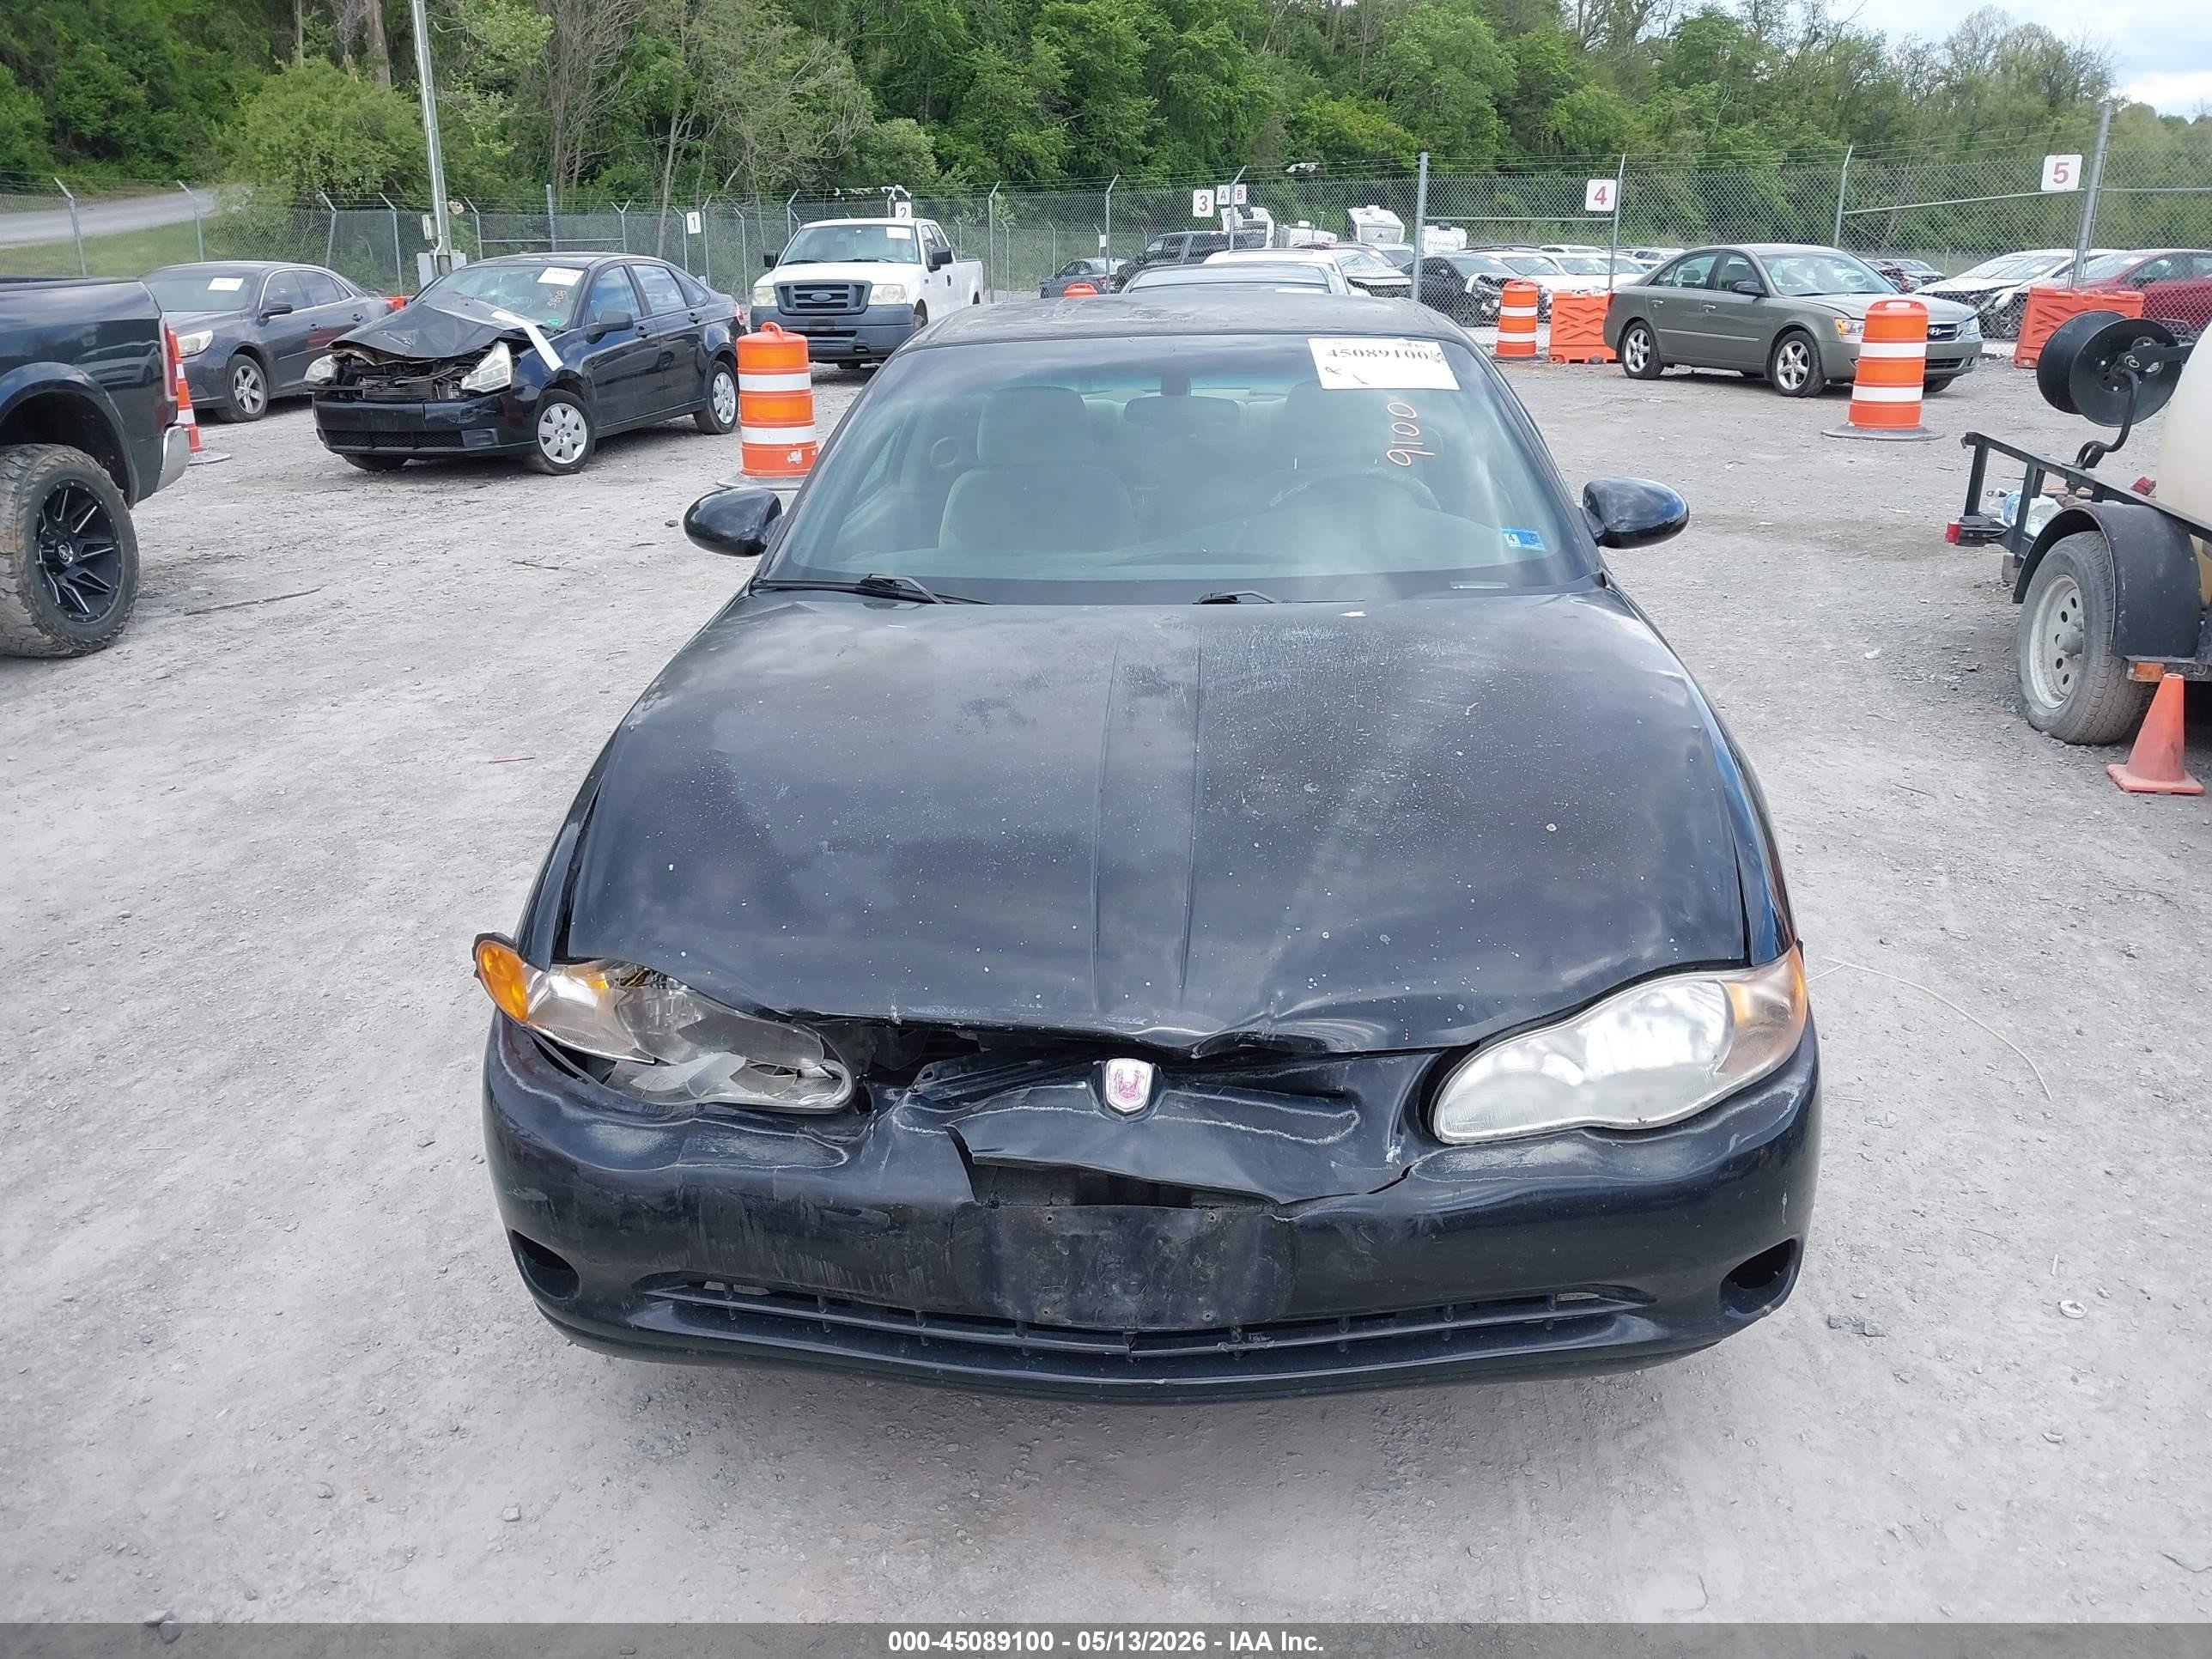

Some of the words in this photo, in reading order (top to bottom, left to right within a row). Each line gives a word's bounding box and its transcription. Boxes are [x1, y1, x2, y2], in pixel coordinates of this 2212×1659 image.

[2053, 162, 2069, 184] 5
[1199, 195, 1208, 211] 3
[1594, 185, 1607, 205] 4
[691, 216, 696, 229] 1
[1387, 402, 1436, 466] 9100
